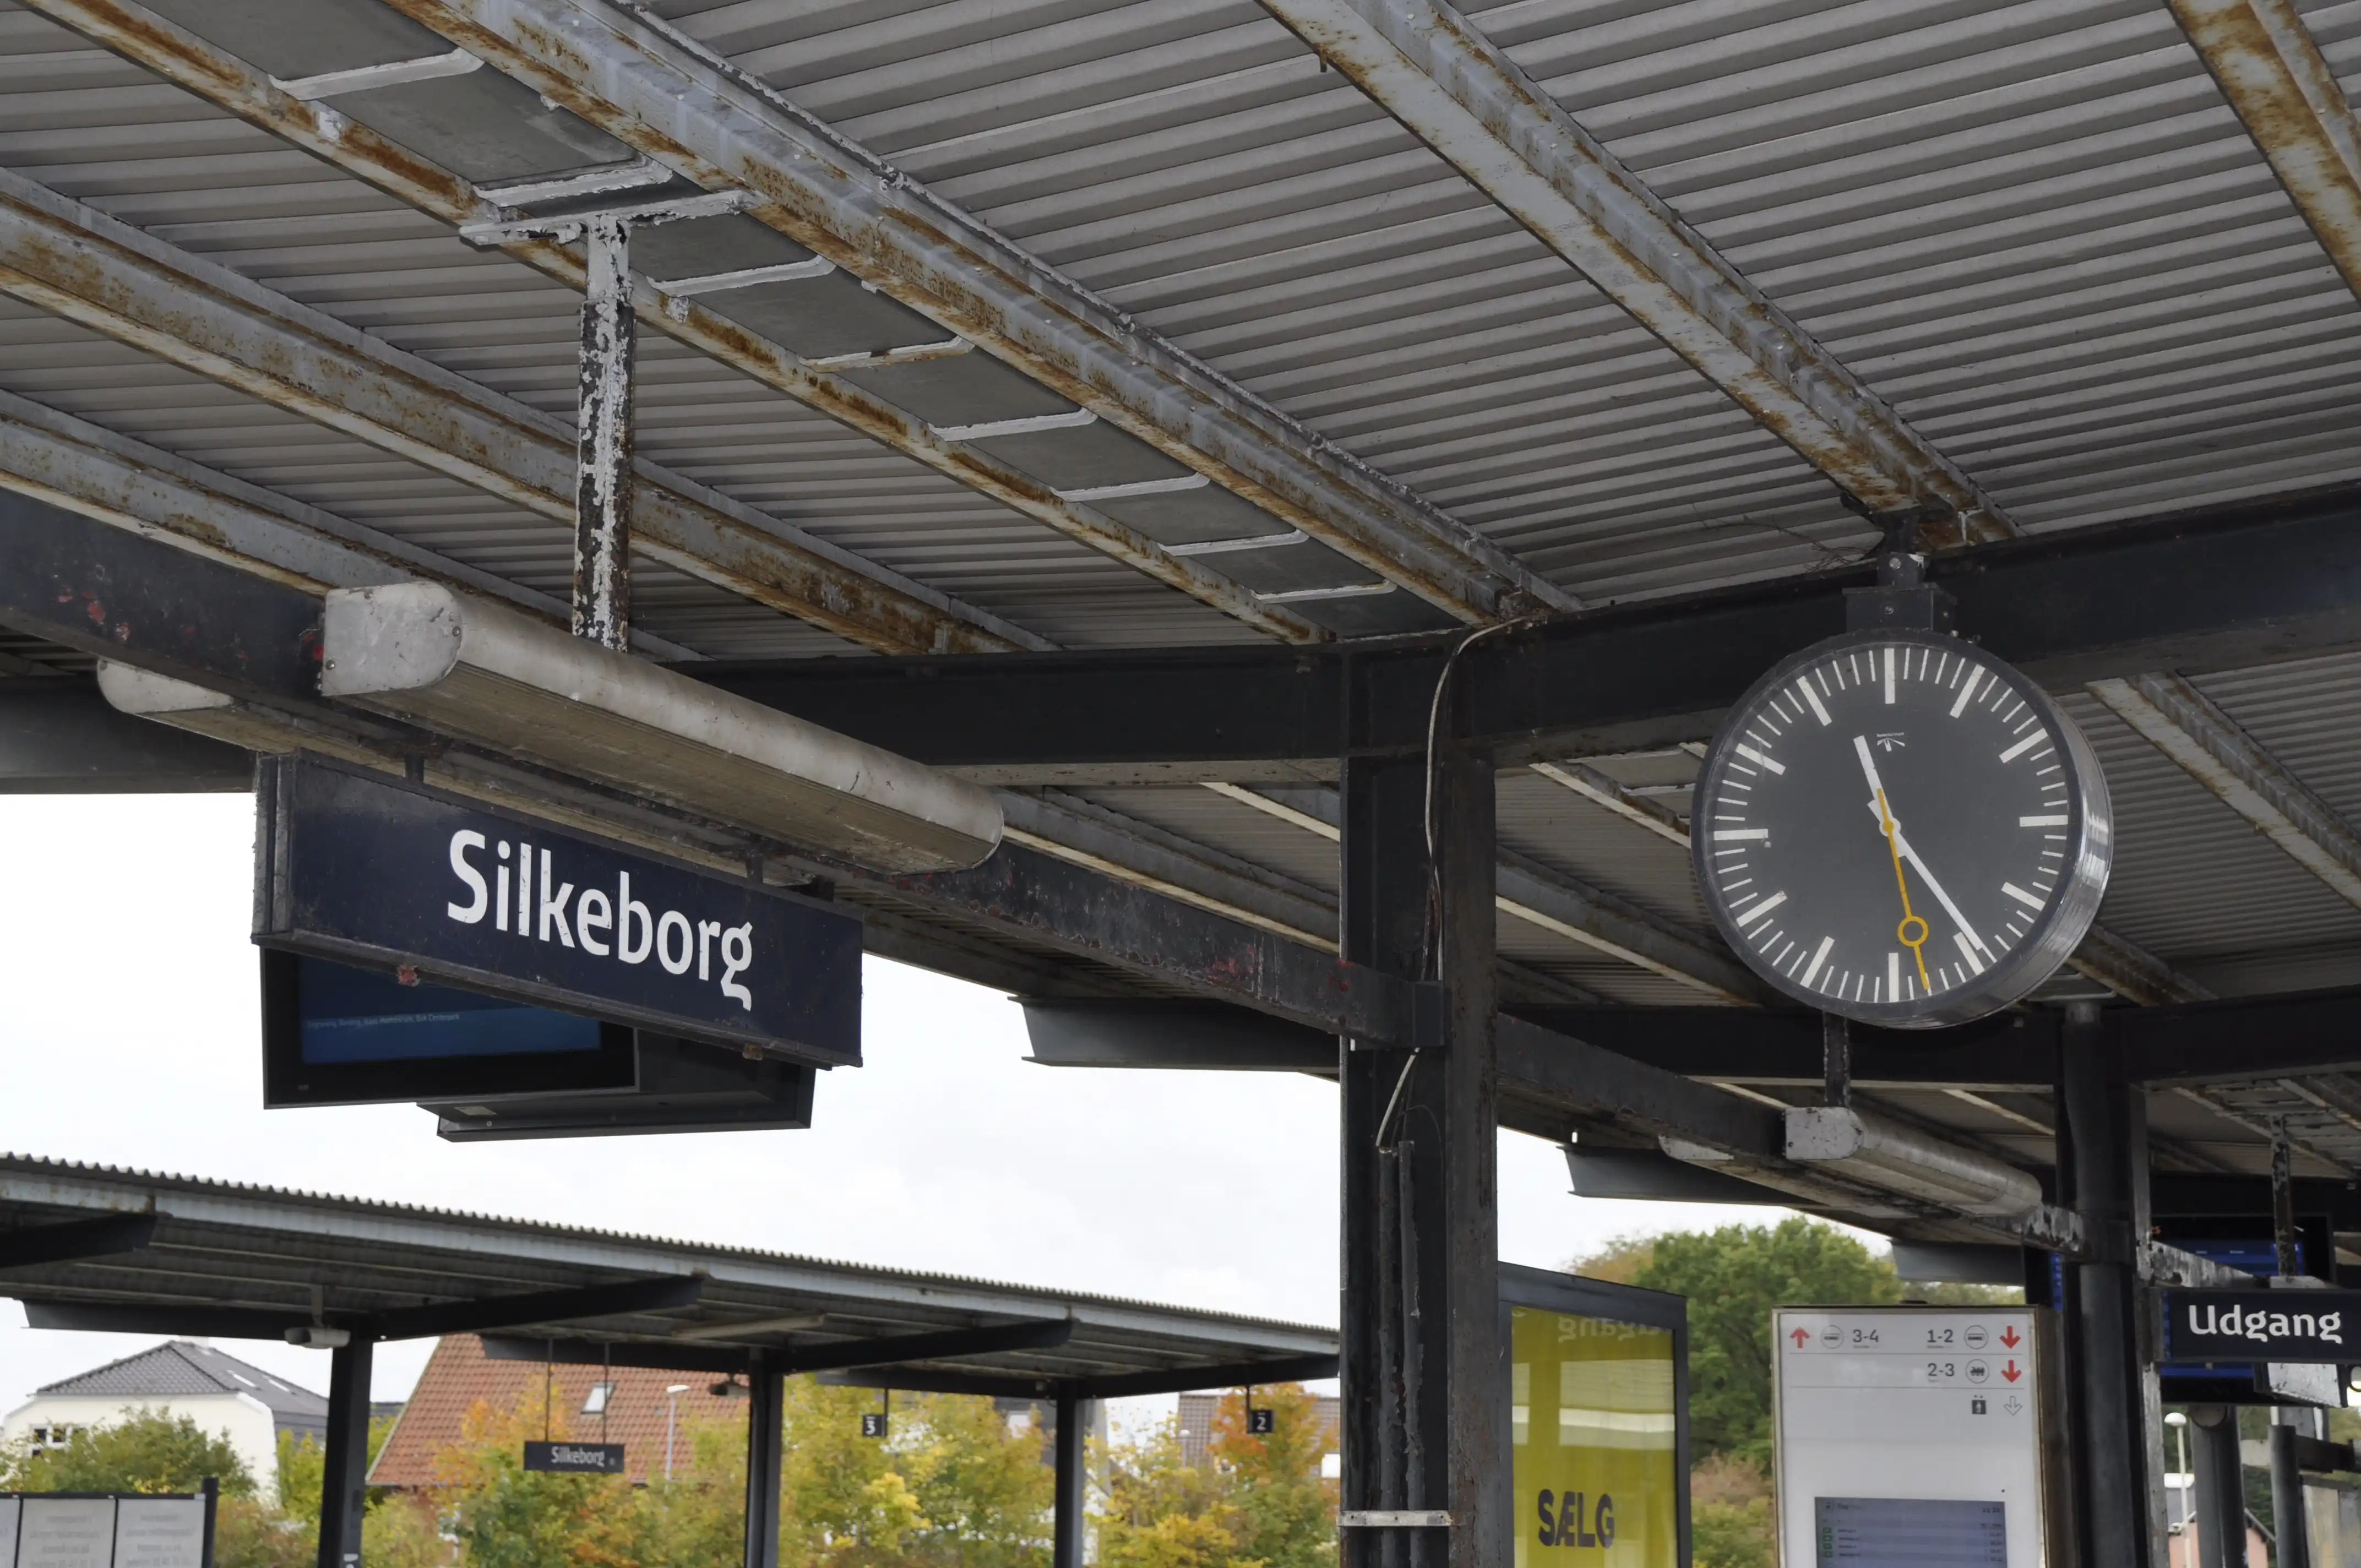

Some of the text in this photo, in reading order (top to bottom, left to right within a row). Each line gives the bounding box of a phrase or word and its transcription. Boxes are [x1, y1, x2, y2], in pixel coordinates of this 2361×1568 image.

[448, 829, 752, 1011] Silkeborg
[2189, 1304, 2342, 1344] Udgang
[1853, 1329, 1879, 1343] 3-4
[1927, 1329, 1954, 1343] 1-2
[1928, 1363, 1955, 1377] 2-3
[865, 1420, 876, 1435] 3
[1256, 1416, 1266, 1431] 2
[551, 1445, 605, 1468] Silkeborg
[1537, 1488, 1615, 1549] SÆLG
